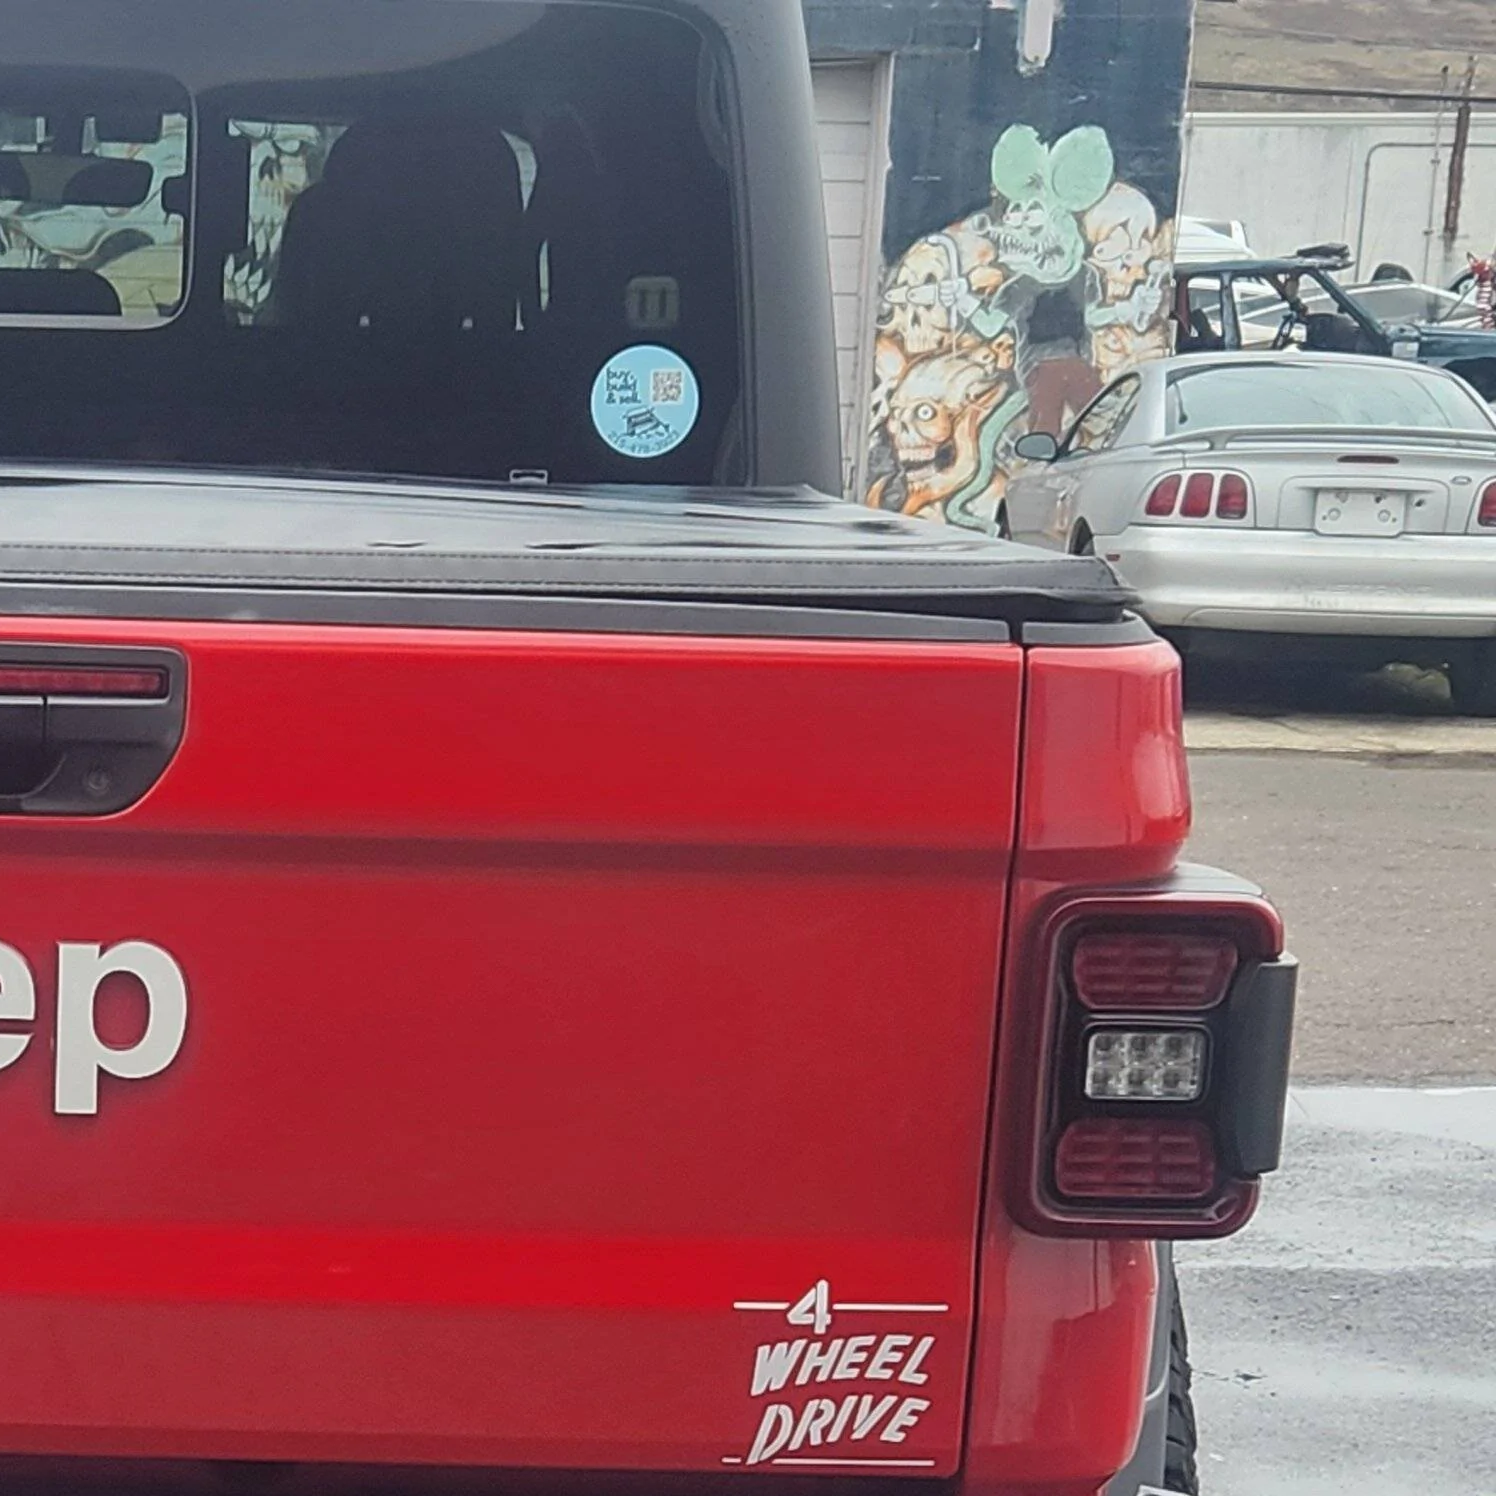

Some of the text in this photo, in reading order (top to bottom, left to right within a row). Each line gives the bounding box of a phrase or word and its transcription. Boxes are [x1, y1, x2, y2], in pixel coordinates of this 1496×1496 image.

[605, 391, 617, 404] &
[786, 1279, 832, 1335] 4
[750, 1334, 936, 1396] WHEEL
[746, 1394, 931, 1465] DRIVE
